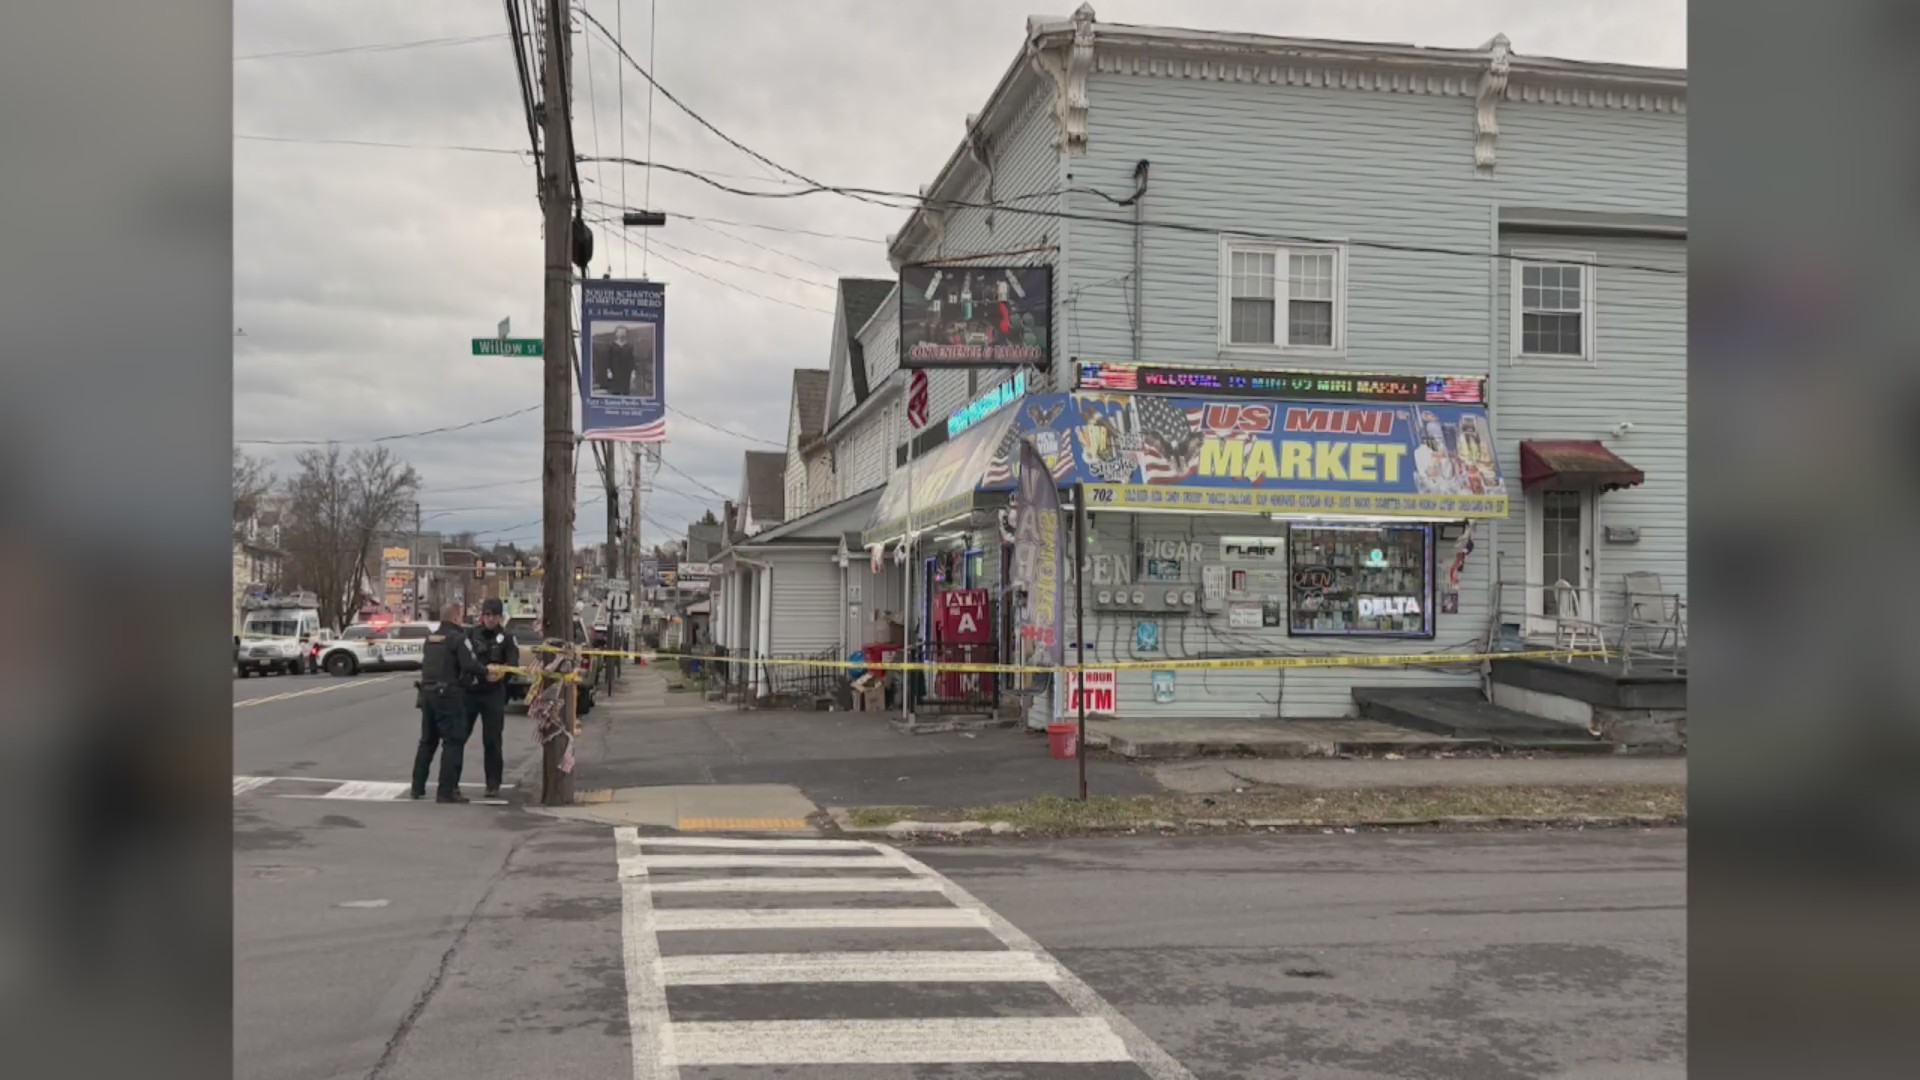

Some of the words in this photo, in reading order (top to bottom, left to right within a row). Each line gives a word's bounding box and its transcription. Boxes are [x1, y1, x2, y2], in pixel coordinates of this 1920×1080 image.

[585, 288, 614, 299] SOUTH
[480, 340, 522, 354] Willow
[1317, 380, 1352, 392] MINI
[1206, 403, 1272, 432] US
[1284, 408, 1395, 436] MINI
[1199, 438, 1407, 482] MARKET
[1093, 488, 1114, 502] 702
[1358, 596, 1421, 616] DELTA
[1085, 671, 1113, 682] HOUR
[1071, 688, 1112, 710] ATM
